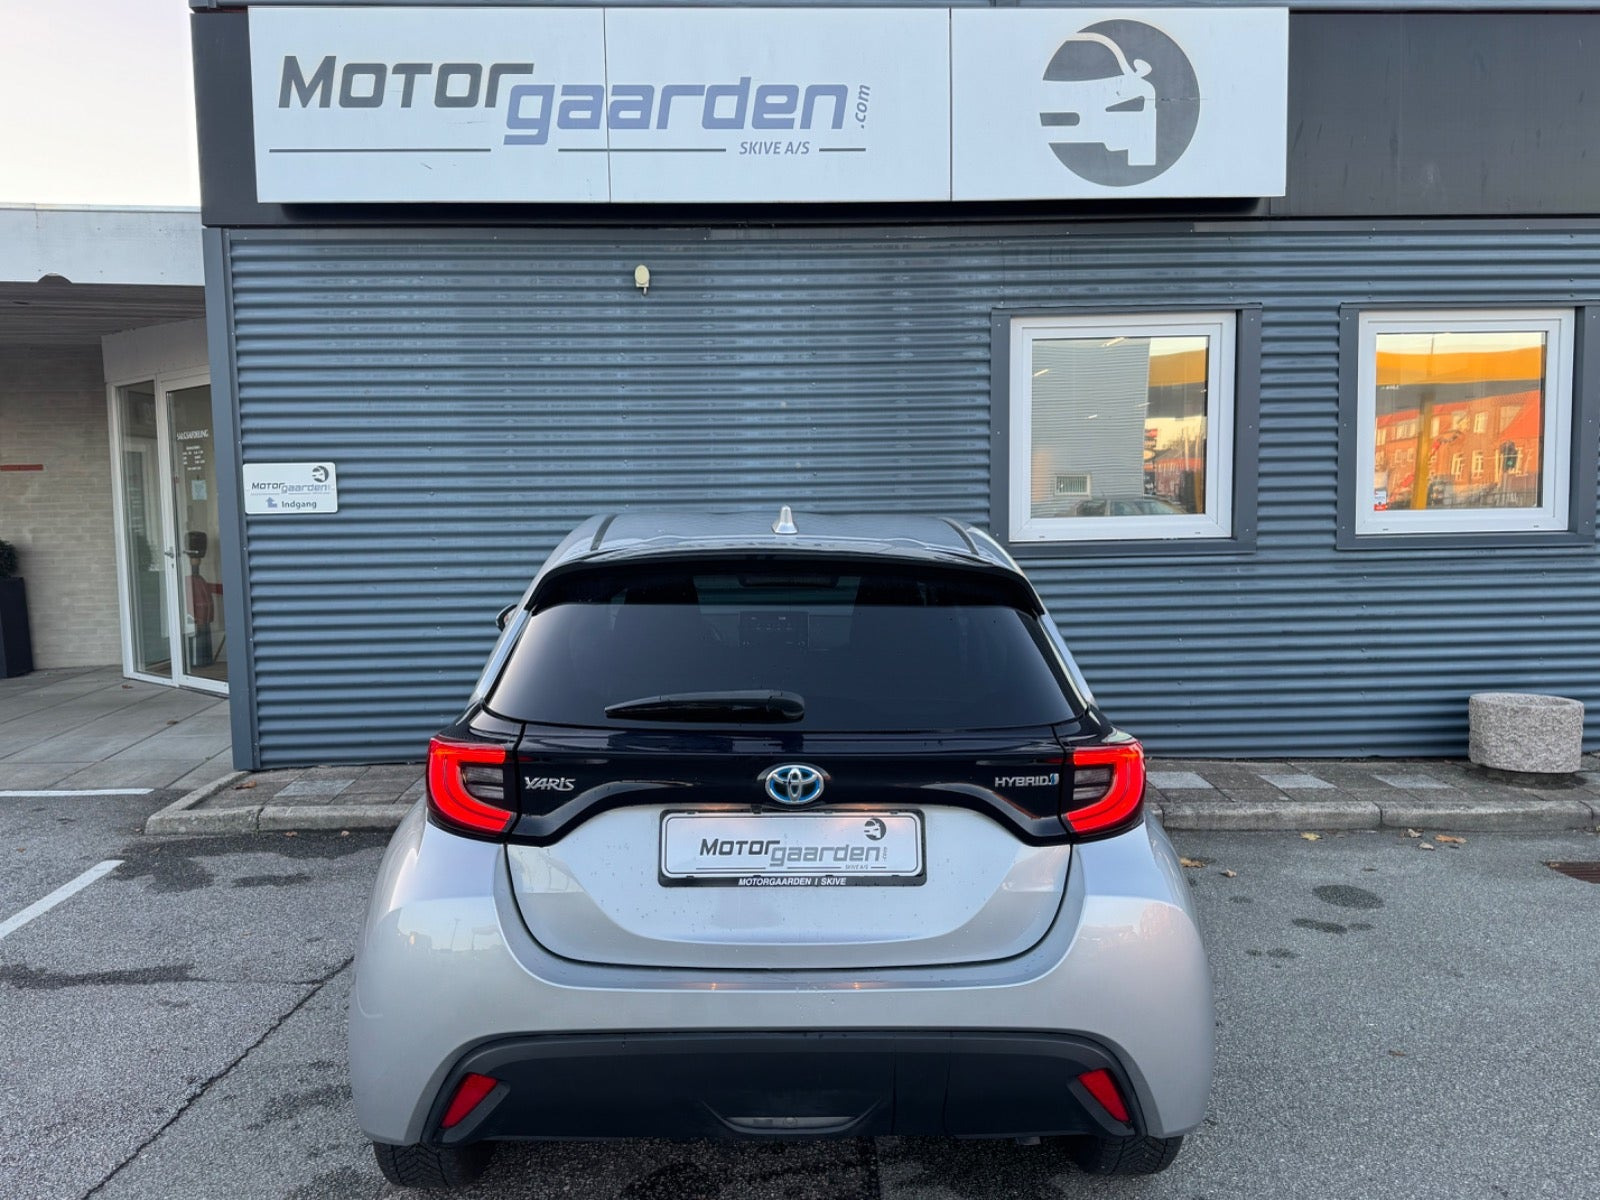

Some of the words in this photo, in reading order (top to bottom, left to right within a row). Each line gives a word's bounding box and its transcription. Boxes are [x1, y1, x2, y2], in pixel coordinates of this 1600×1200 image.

[855, 83, 871, 130] .com
[739, 141, 782, 155] SKIVE
[784, 141, 810, 155] A/S
[281, 501, 317, 509] Indgang
[524, 776, 576, 791] YARIS
[994, 776, 1049, 787] HYBRID
[738, 877, 811, 886] MOTORGAARDEN
[820, 877, 847, 886] SKIVE
